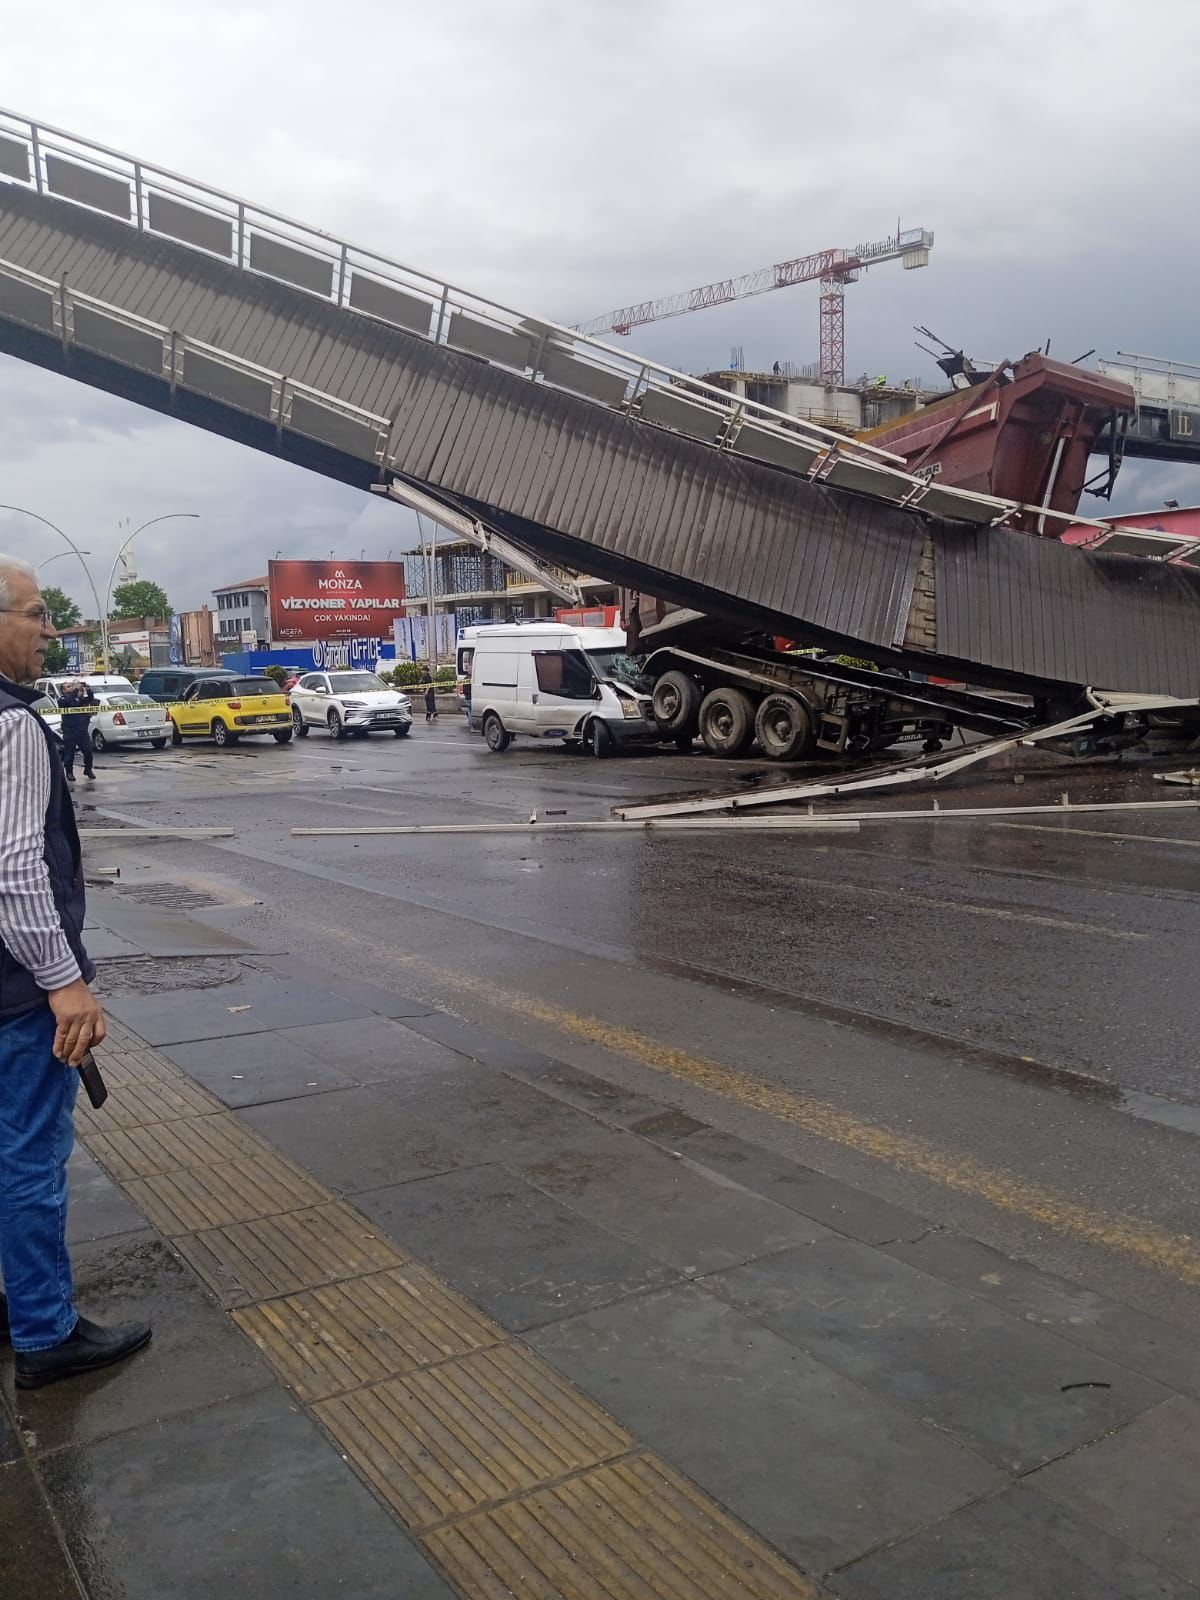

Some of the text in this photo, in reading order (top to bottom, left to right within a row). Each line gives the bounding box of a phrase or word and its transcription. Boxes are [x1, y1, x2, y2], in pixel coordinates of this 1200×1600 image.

[318, 579, 362, 590] MONZA
[280, 596, 400, 609] VİZYONER YAPILAR
[313, 613, 371, 623] ÇOK YAKINDA!
[351, 637, 382, 660] OFFICE
